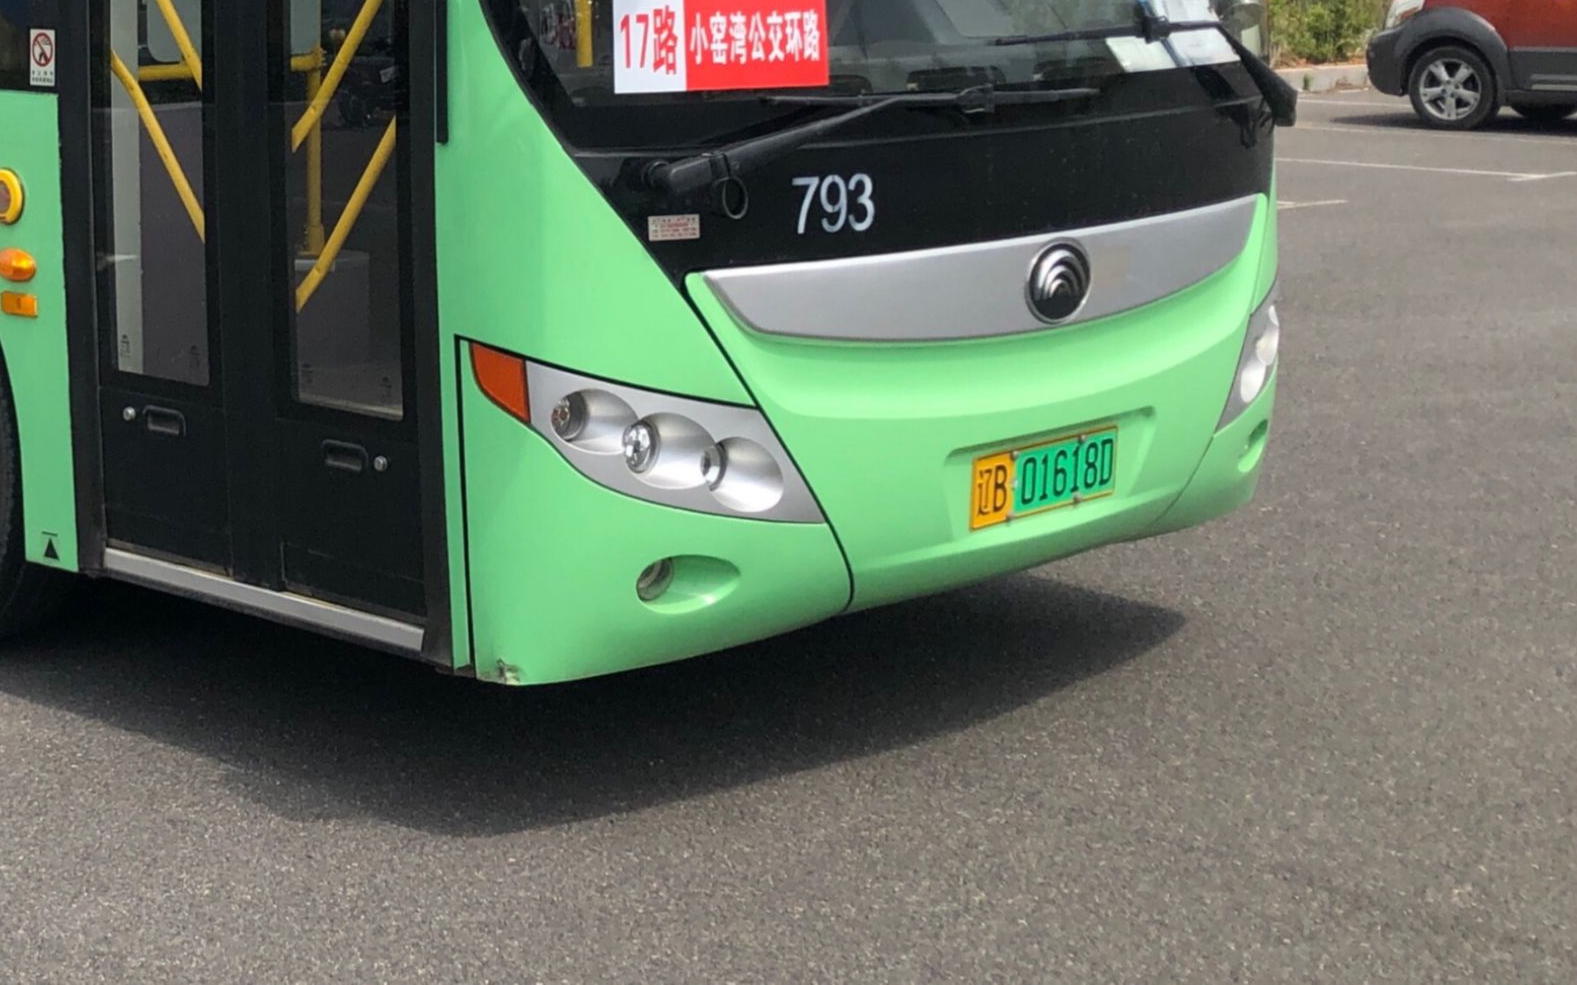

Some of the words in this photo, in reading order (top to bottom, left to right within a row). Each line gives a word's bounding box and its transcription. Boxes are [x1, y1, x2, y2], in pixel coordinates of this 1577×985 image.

[619, 5, 679, 75] 17路
[690, 10, 821, 65] 小窑湾公交环路
[792, 173, 876, 235] 793
